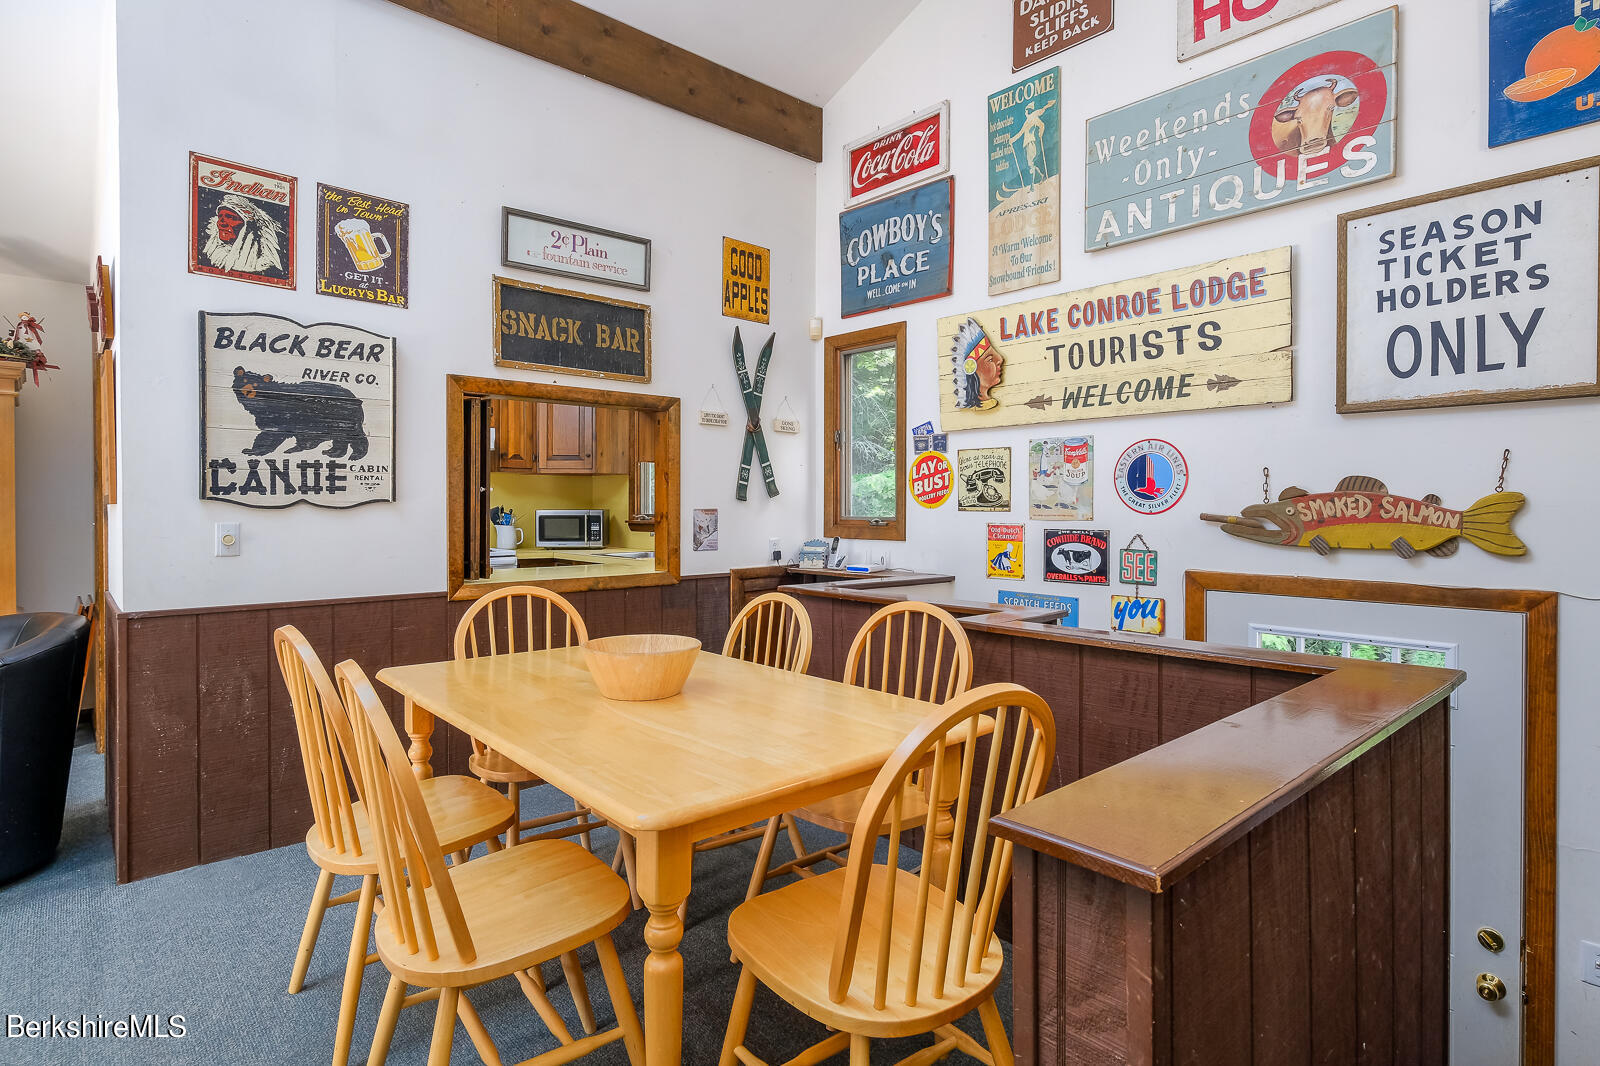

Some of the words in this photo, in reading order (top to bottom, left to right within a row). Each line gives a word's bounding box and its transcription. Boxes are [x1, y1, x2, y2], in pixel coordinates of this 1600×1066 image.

[1025, 34, 1059, 57] KEEP
[1062, 15, 1100, 40] BACK
[1034, 4, 1089, 40] CLIFFS
[989, 72, 1055, 114] WELCOME
[872, 130, 904, 151] DRINK
[1094, 90, 1252, 165] Weekends
[853, 123, 939, 188] Coca-Cola
[200, 170, 288, 203] Indian
[1094, 135, 1378, 243] ANTIQUES
[335, 204, 349, 214] in
[347, 196, 372, 209] Best
[375, 202, 405, 217] Head
[996, 197, 1049, 218] APRES-SKI
[846, 209, 943, 268] COWBOY'S
[1379, 199, 1543, 256] SEASON
[542, 245, 590, 269] fountain
[591, 262, 628, 276] service
[571, 233, 609, 260] Plain
[992, 245, 998, 257] A
[998, 241, 1020, 255] Warm
[1020, 233, 1053, 249] Welcome
[1010, 254, 1018, 267] To
[1020, 252, 1033, 264] Our
[1377, 232, 1532, 283] TICKET
[344, 271, 369, 282] GET
[371, 275, 384, 285] IT
[730, 246, 762, 282] GOOD
[857, 249, 930, 287] PLACE
[989, 266, 1025, 288] Snowbound
[320, 278, 375, 300] LUCKY'S
[375, 288, 405, 305] BAR
[723, 278, 768, 316] APPLES
[908, 278, 917, 290] IN
[1376, 262, 1550, 314] HOLDERS
[999, 307, 1060, 343] LAKE
[1068, 287, 1162, 331] CONROE
[1171, 267, 1268, 313] LODGE
[213, 326, 309, 357] BLACK
[315, 337, 385, 363] BEAR
[501, 309, 583, 346] SNACK
[595, 323, 641, 354] BAR
[1045, 319, 1224, 374] TOURISTS
[1386, 307, 1545, 379] ONLY
[301, 367, 350, 383] RIVER
[354, 373, 379, 386] CO.
[1062, 373, 1195, 410] WELCOME
[208, 457, 348, 496] CANOE
[349, 464, 389, 473] CABIN
[912, 458, 937, 480] LAY
[937, 460, 948, 470] OR
[974, 459, 1007, 470] TELEPHONE
[1066, 468, 1086, 479] SOUP
[1117, 444, 1144, 479] EASTERN
[1147, 443, 1165, 452] AIR
[913, 471, 951, 496] BUST
[1120, 485, 1129, 497] THE
[1128, 496, 1146, 509] GREAT
[1148, 498, 1169, 510] SILVER
[1169, 482, 1182, 499] FLEET
[1297, 494, 1372, 522] SMOKED
[1380, 496, 1460, 529] SALMON
[1046, 534, 1080, 548] COWHIDE
[1080, 534, 1107, 550] BRAND
[1046, 572, 1078, 581] OVERALLS
[1084, 575, 1107, 583] PANTS
[1122, 551, 1155, 583] SEE
[1003, 596, 1040, 609] SCRATCH
[1043, 601, 1072, 614] FEEDS
[1113, 598, 1159, 631] you
